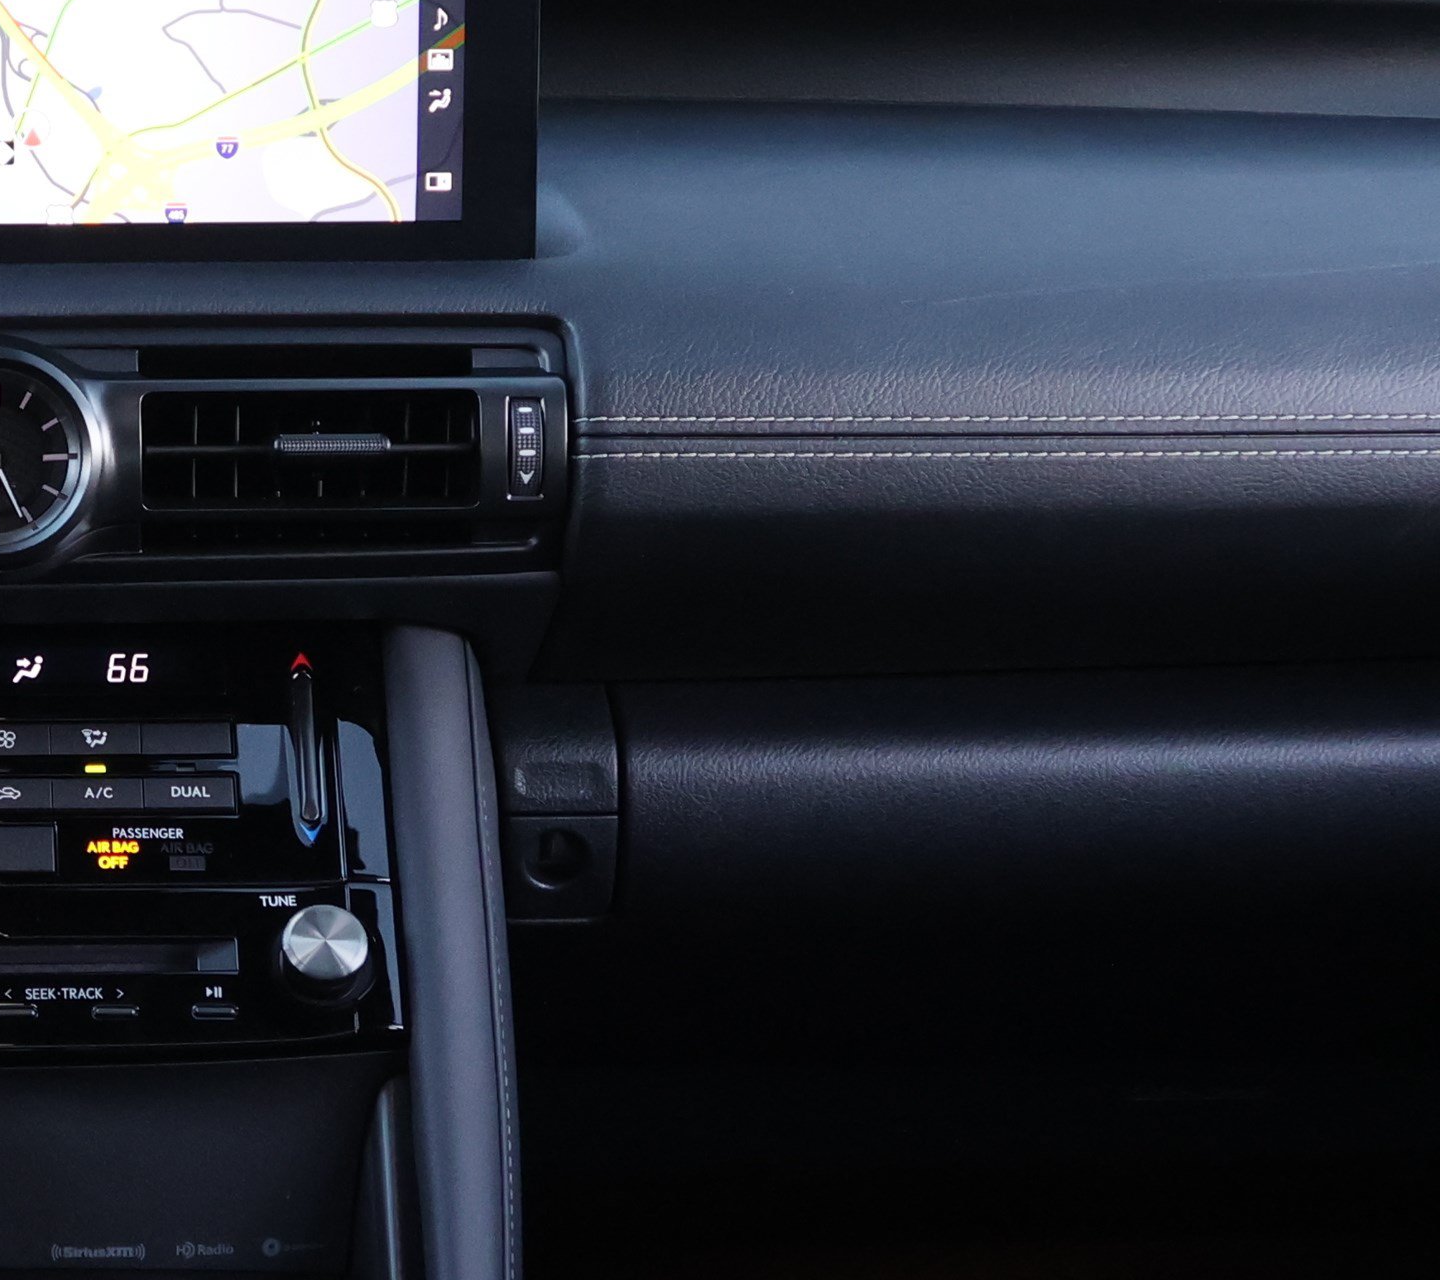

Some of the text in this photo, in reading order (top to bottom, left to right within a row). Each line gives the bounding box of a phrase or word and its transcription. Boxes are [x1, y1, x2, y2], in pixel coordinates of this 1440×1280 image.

[221, 143, 234, 154] 77
[106, 653, 149, 683] 66
[84, 787, 113, 799] A/C
[171, 786, 211, 798] DUAL
[112, 827, 184, 840] PASSENGER
[86, 841, 140, 854] AIR BAG
[98, 855, 129, 869] OFF
[259, 895, 298, 907] TUNE
[197, 1243, 235, 1256] Radio
